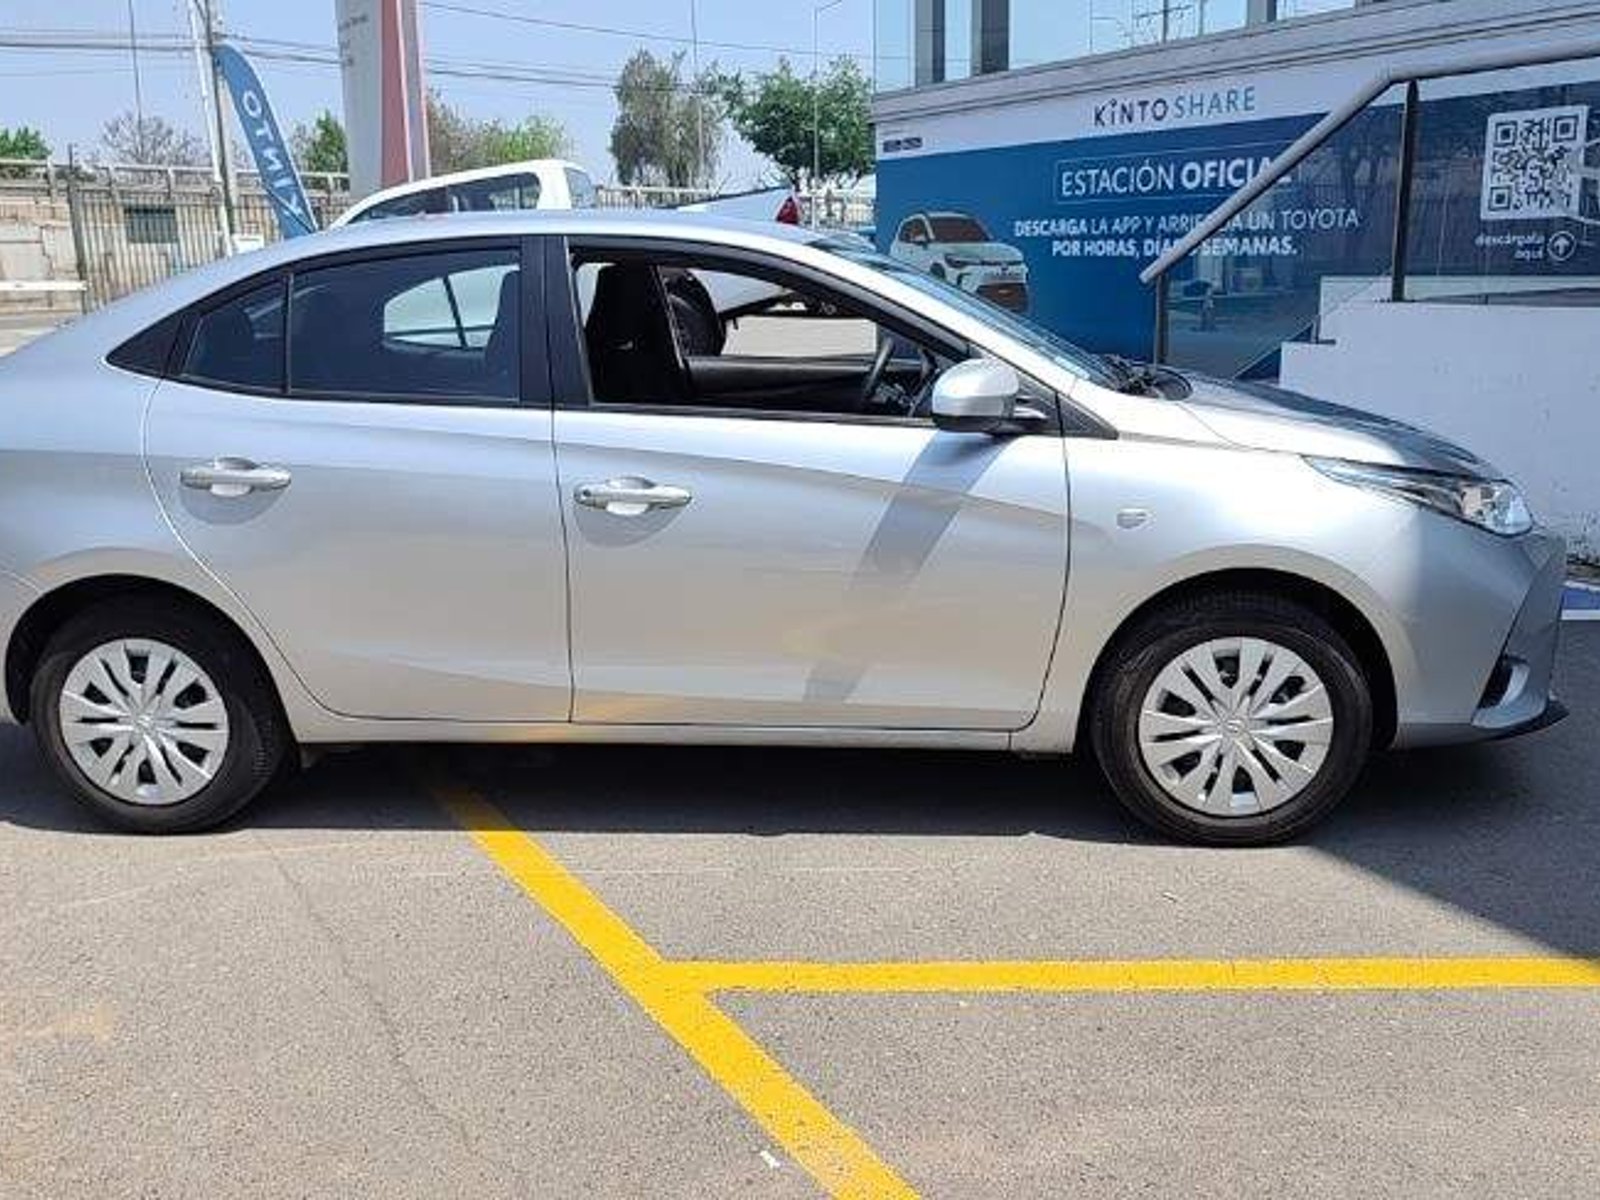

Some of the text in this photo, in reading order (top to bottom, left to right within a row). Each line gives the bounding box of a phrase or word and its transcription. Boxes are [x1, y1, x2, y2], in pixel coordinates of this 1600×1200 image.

[1173, 86, 1255, 118] SHARE
[1061, 159, 1174, 197] ESTACIÓN
[1014, 218, 1088, 237] DESCARGA
[1091, 218, 1108, 235] LA
[1111, 215, 1142, 234] APP
[1143, 215, 1155, 233] Y
[1249, 209, 1275, 230] UN
[1280, 207, 1359, 230] TOYOTA
[1052, 240, 1081, 257] POR
[1083, 238, 1139, 260] HORAS,
[1202, 235, 1298, 257] SEMANAS.
